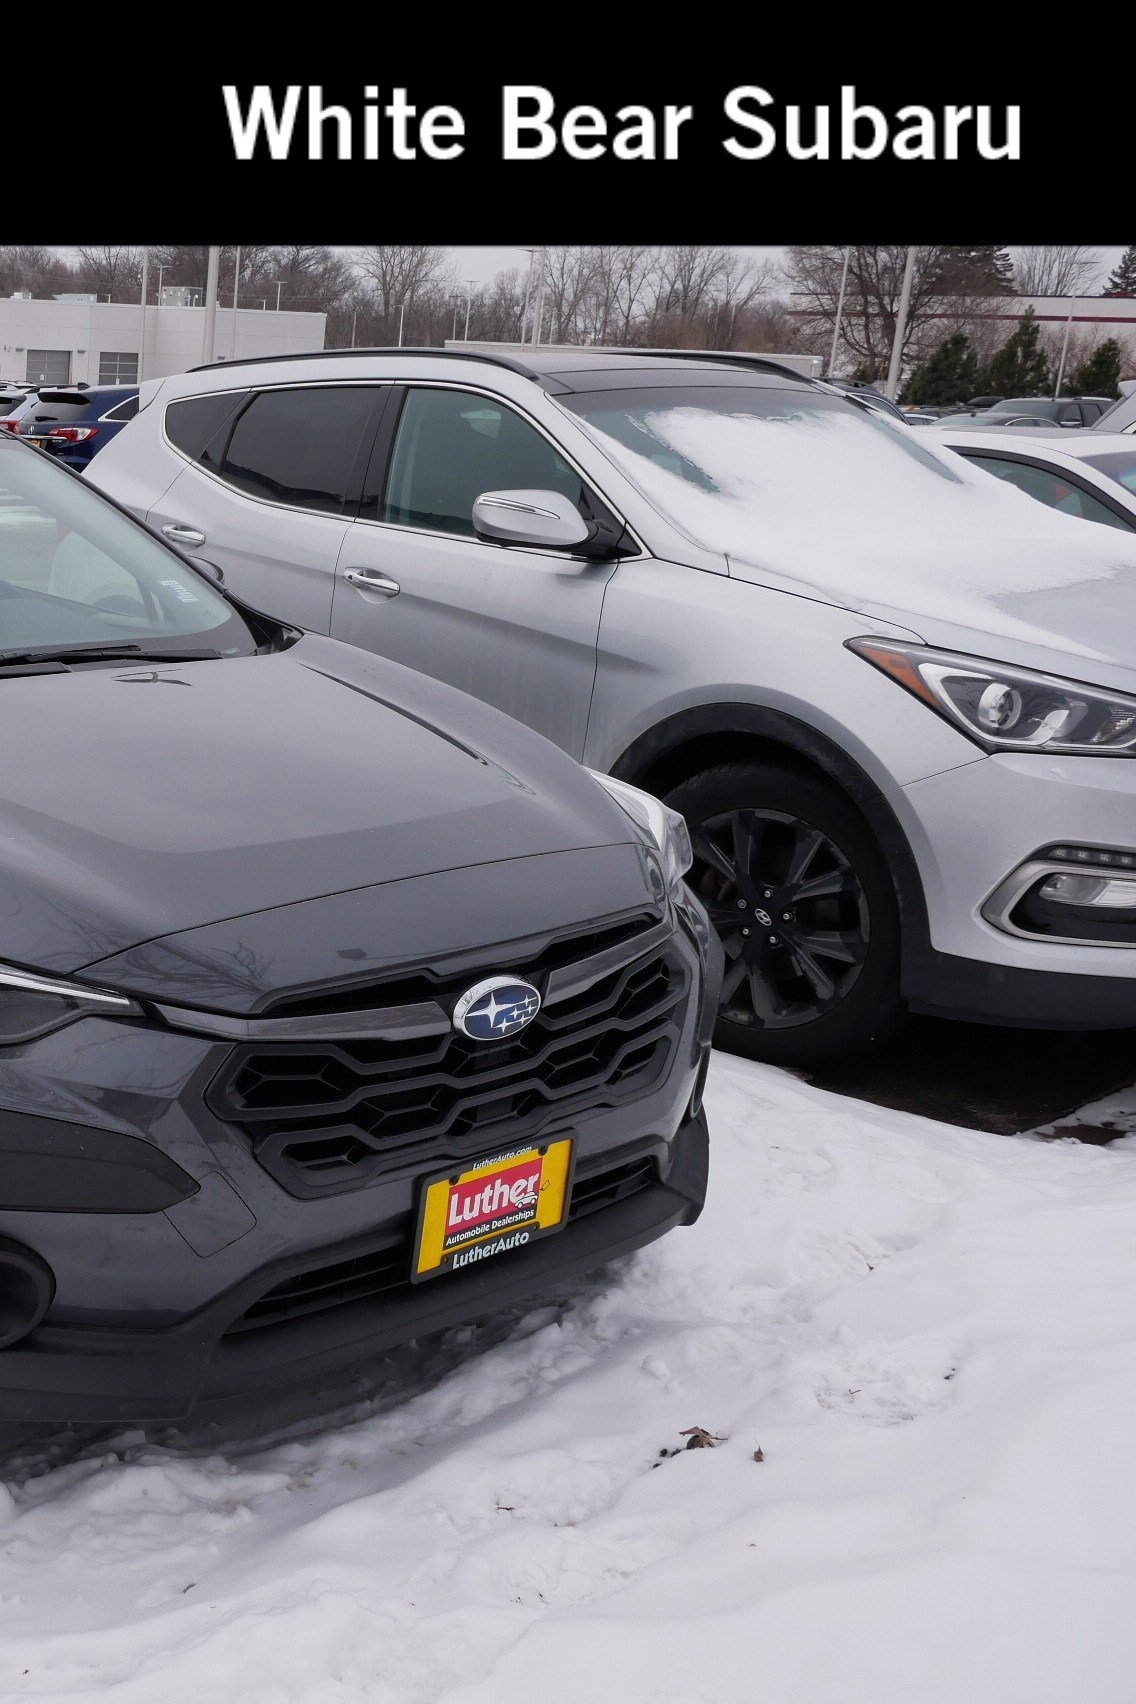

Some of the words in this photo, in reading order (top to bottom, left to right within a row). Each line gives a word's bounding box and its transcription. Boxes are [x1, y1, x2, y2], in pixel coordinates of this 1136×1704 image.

[472, 1146, 532, 1171] LutherAuto.com
[448, 1172, 540, 1227] Luther
[445, 1223, 490, 1246] Automobile
[491, 1208, 535, 1231] Dealerships
[452, 1231, 530, 1270] LutherAuto
